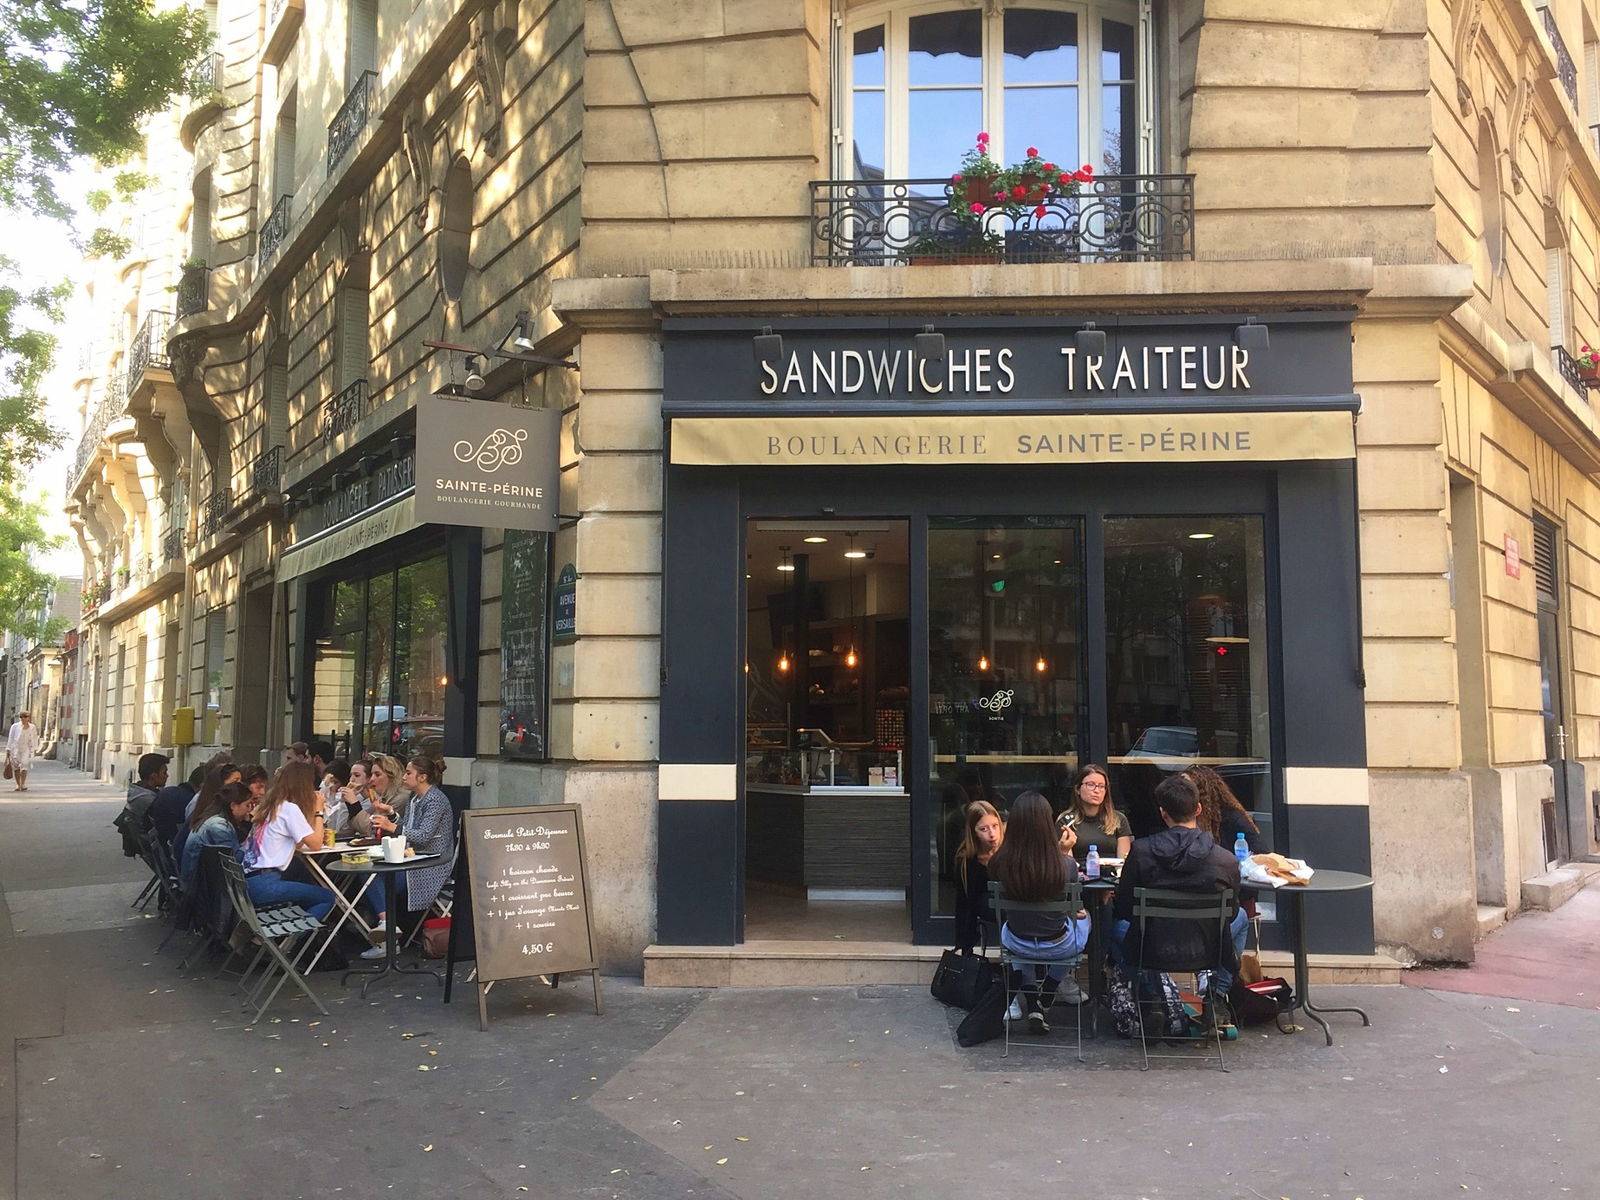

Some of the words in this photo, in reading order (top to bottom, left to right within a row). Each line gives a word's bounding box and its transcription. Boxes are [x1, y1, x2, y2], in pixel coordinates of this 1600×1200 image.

[760, 348, 1015, 395] SANDWICHES
[1061, 345, 1251, 391] TRAITEUR
[767, 434, 987, 457] BOULANGERIE
[1017, 427, 1251, 455] SAINTE-PÉRINE
[435, 478, 543, 498] SAINTE-PÉRINE
[437, 495, 492, 506] BOULANGERIE
[494, 500, 542, 510] GOURMANDE
[484, 829, 514, 840] Formule
[516, 826, 568, 839] Petit-Déjeuner
[509, 867, 534, 875] boisson
[508, 892, 538, 901] croissant
[522, 943, 543, 955] 4,50
[546, 942, 553, 952] €
